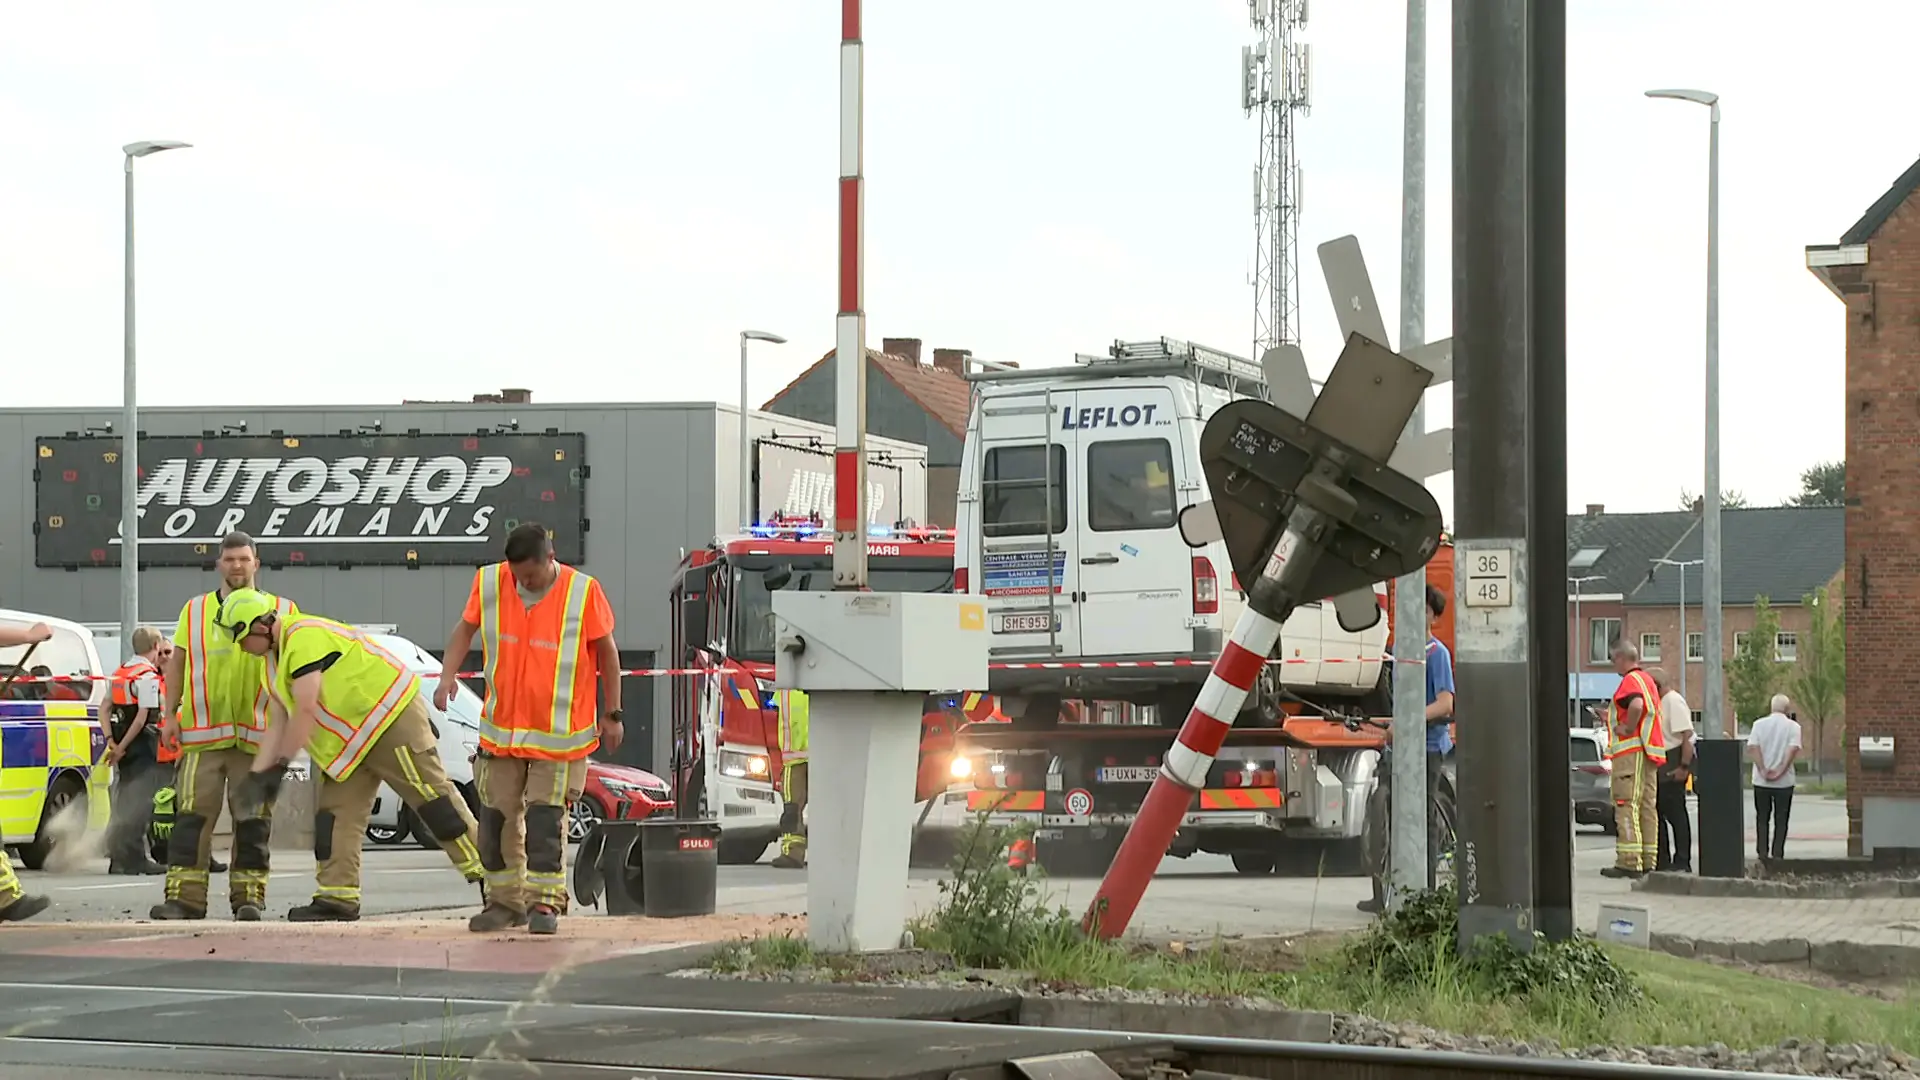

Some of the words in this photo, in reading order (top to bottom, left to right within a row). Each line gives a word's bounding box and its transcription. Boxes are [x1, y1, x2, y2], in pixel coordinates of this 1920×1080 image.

[1061, 404, 1157, 430] LEFLOT
[136, 457, 513, 506] AUTOSHOP
[1021, 552, 1064, 560] VERWARING
[1478, 556, 1498, 572] 36
[1478, 584, 1498, 600] 48
[1072, 796, 1087, 809] 60
[682, 839, 710, 848] SULO
